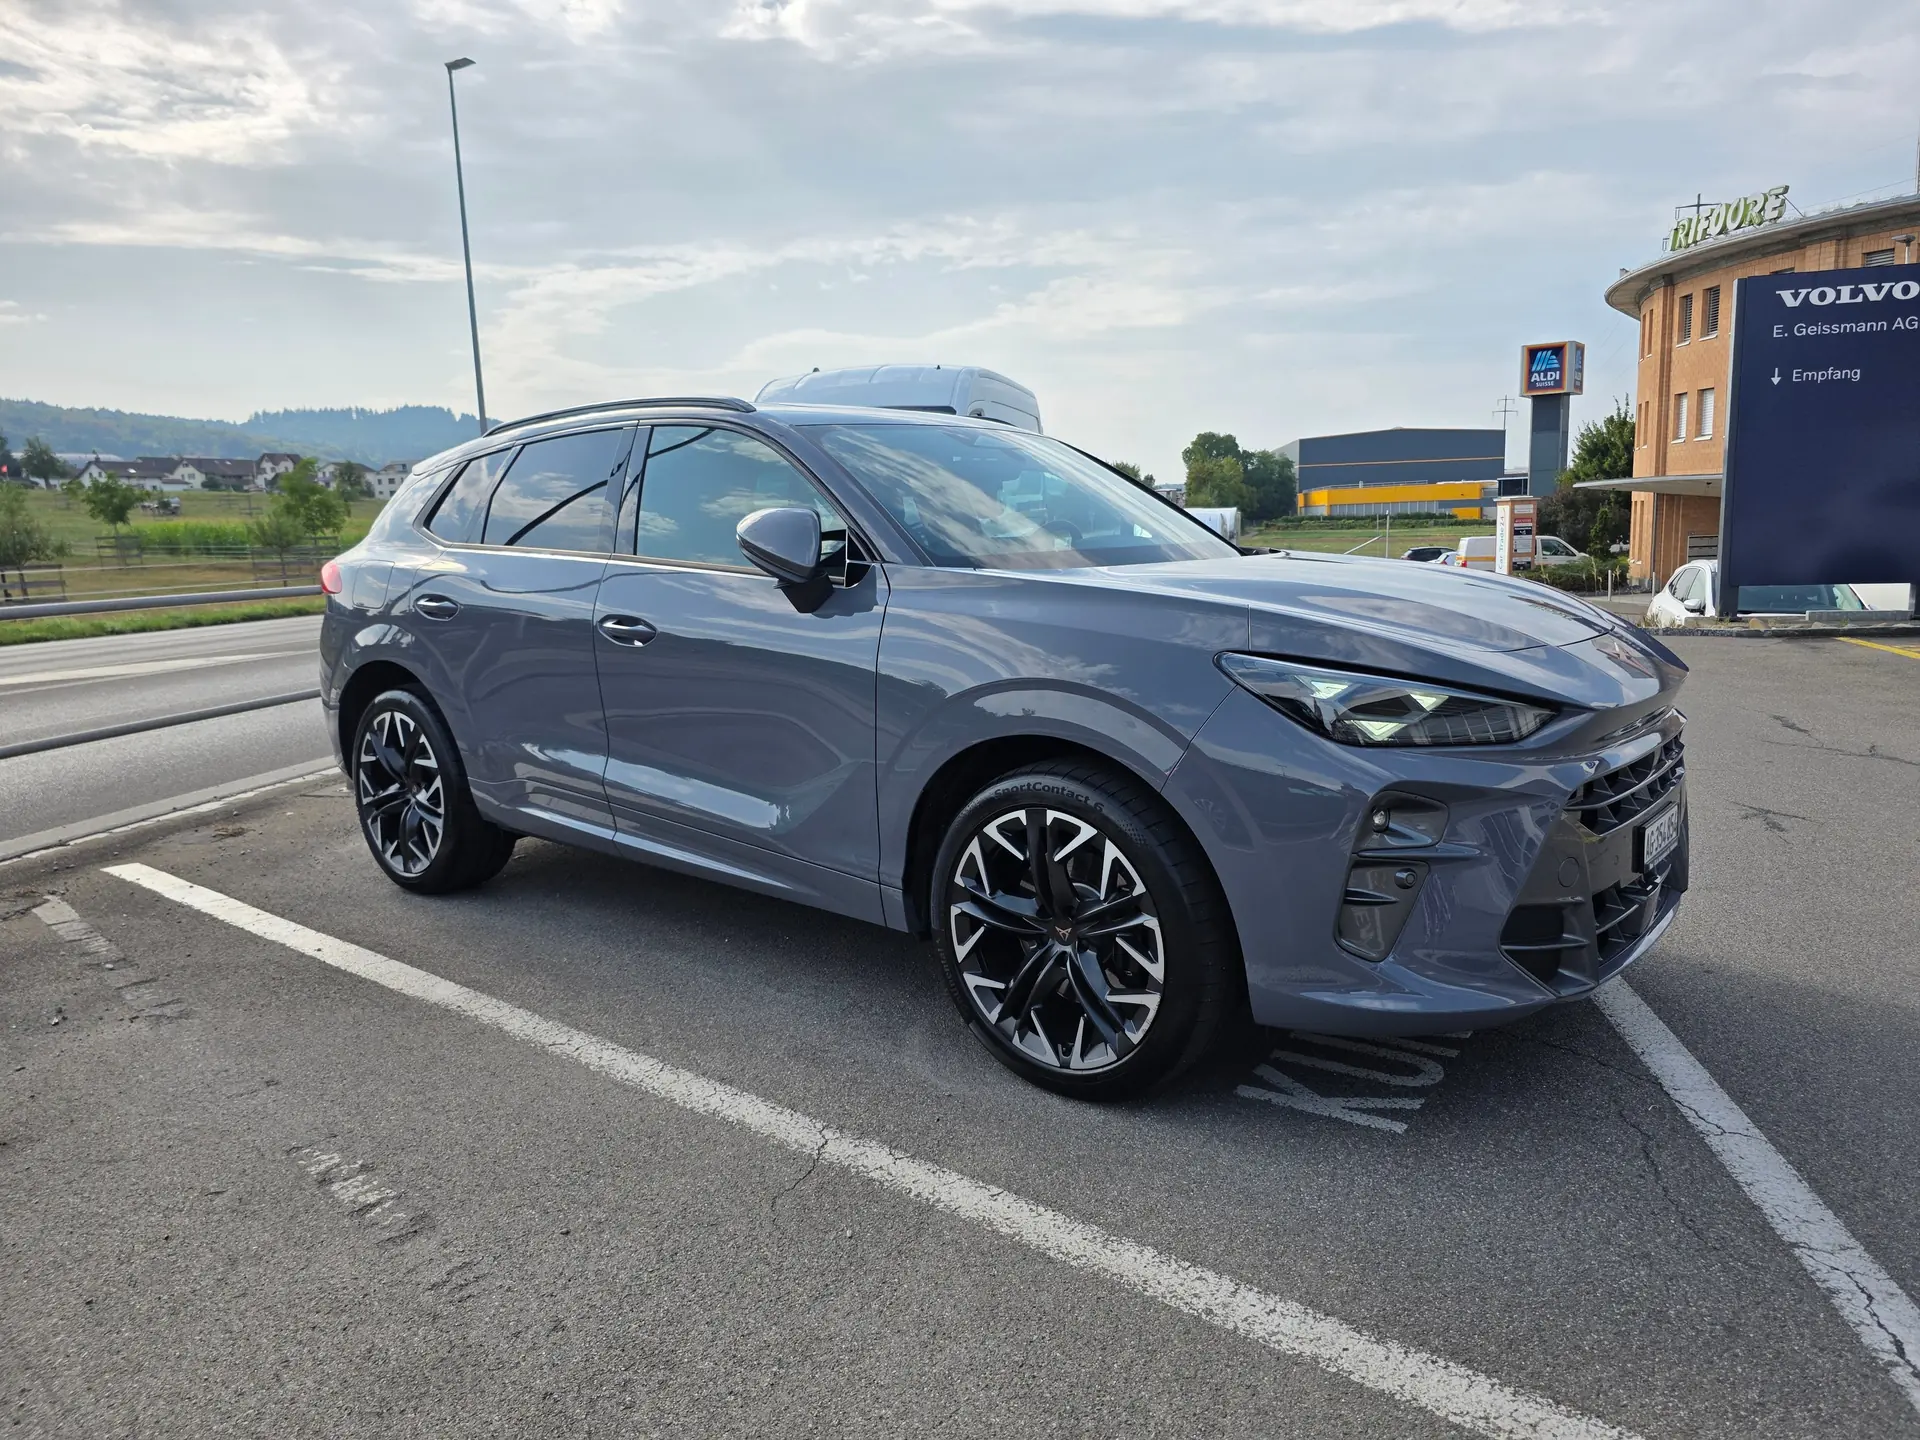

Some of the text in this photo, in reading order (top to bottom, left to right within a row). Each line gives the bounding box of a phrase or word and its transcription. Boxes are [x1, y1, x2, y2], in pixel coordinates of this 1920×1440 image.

[1776, 280, 1920, 308] VOLVO
[1773, 317, 1919, 338] E. Geissmann AG
[1531, 371, 1560, 382] ALDI
[1792, 366, 1861, 384] Empfang
